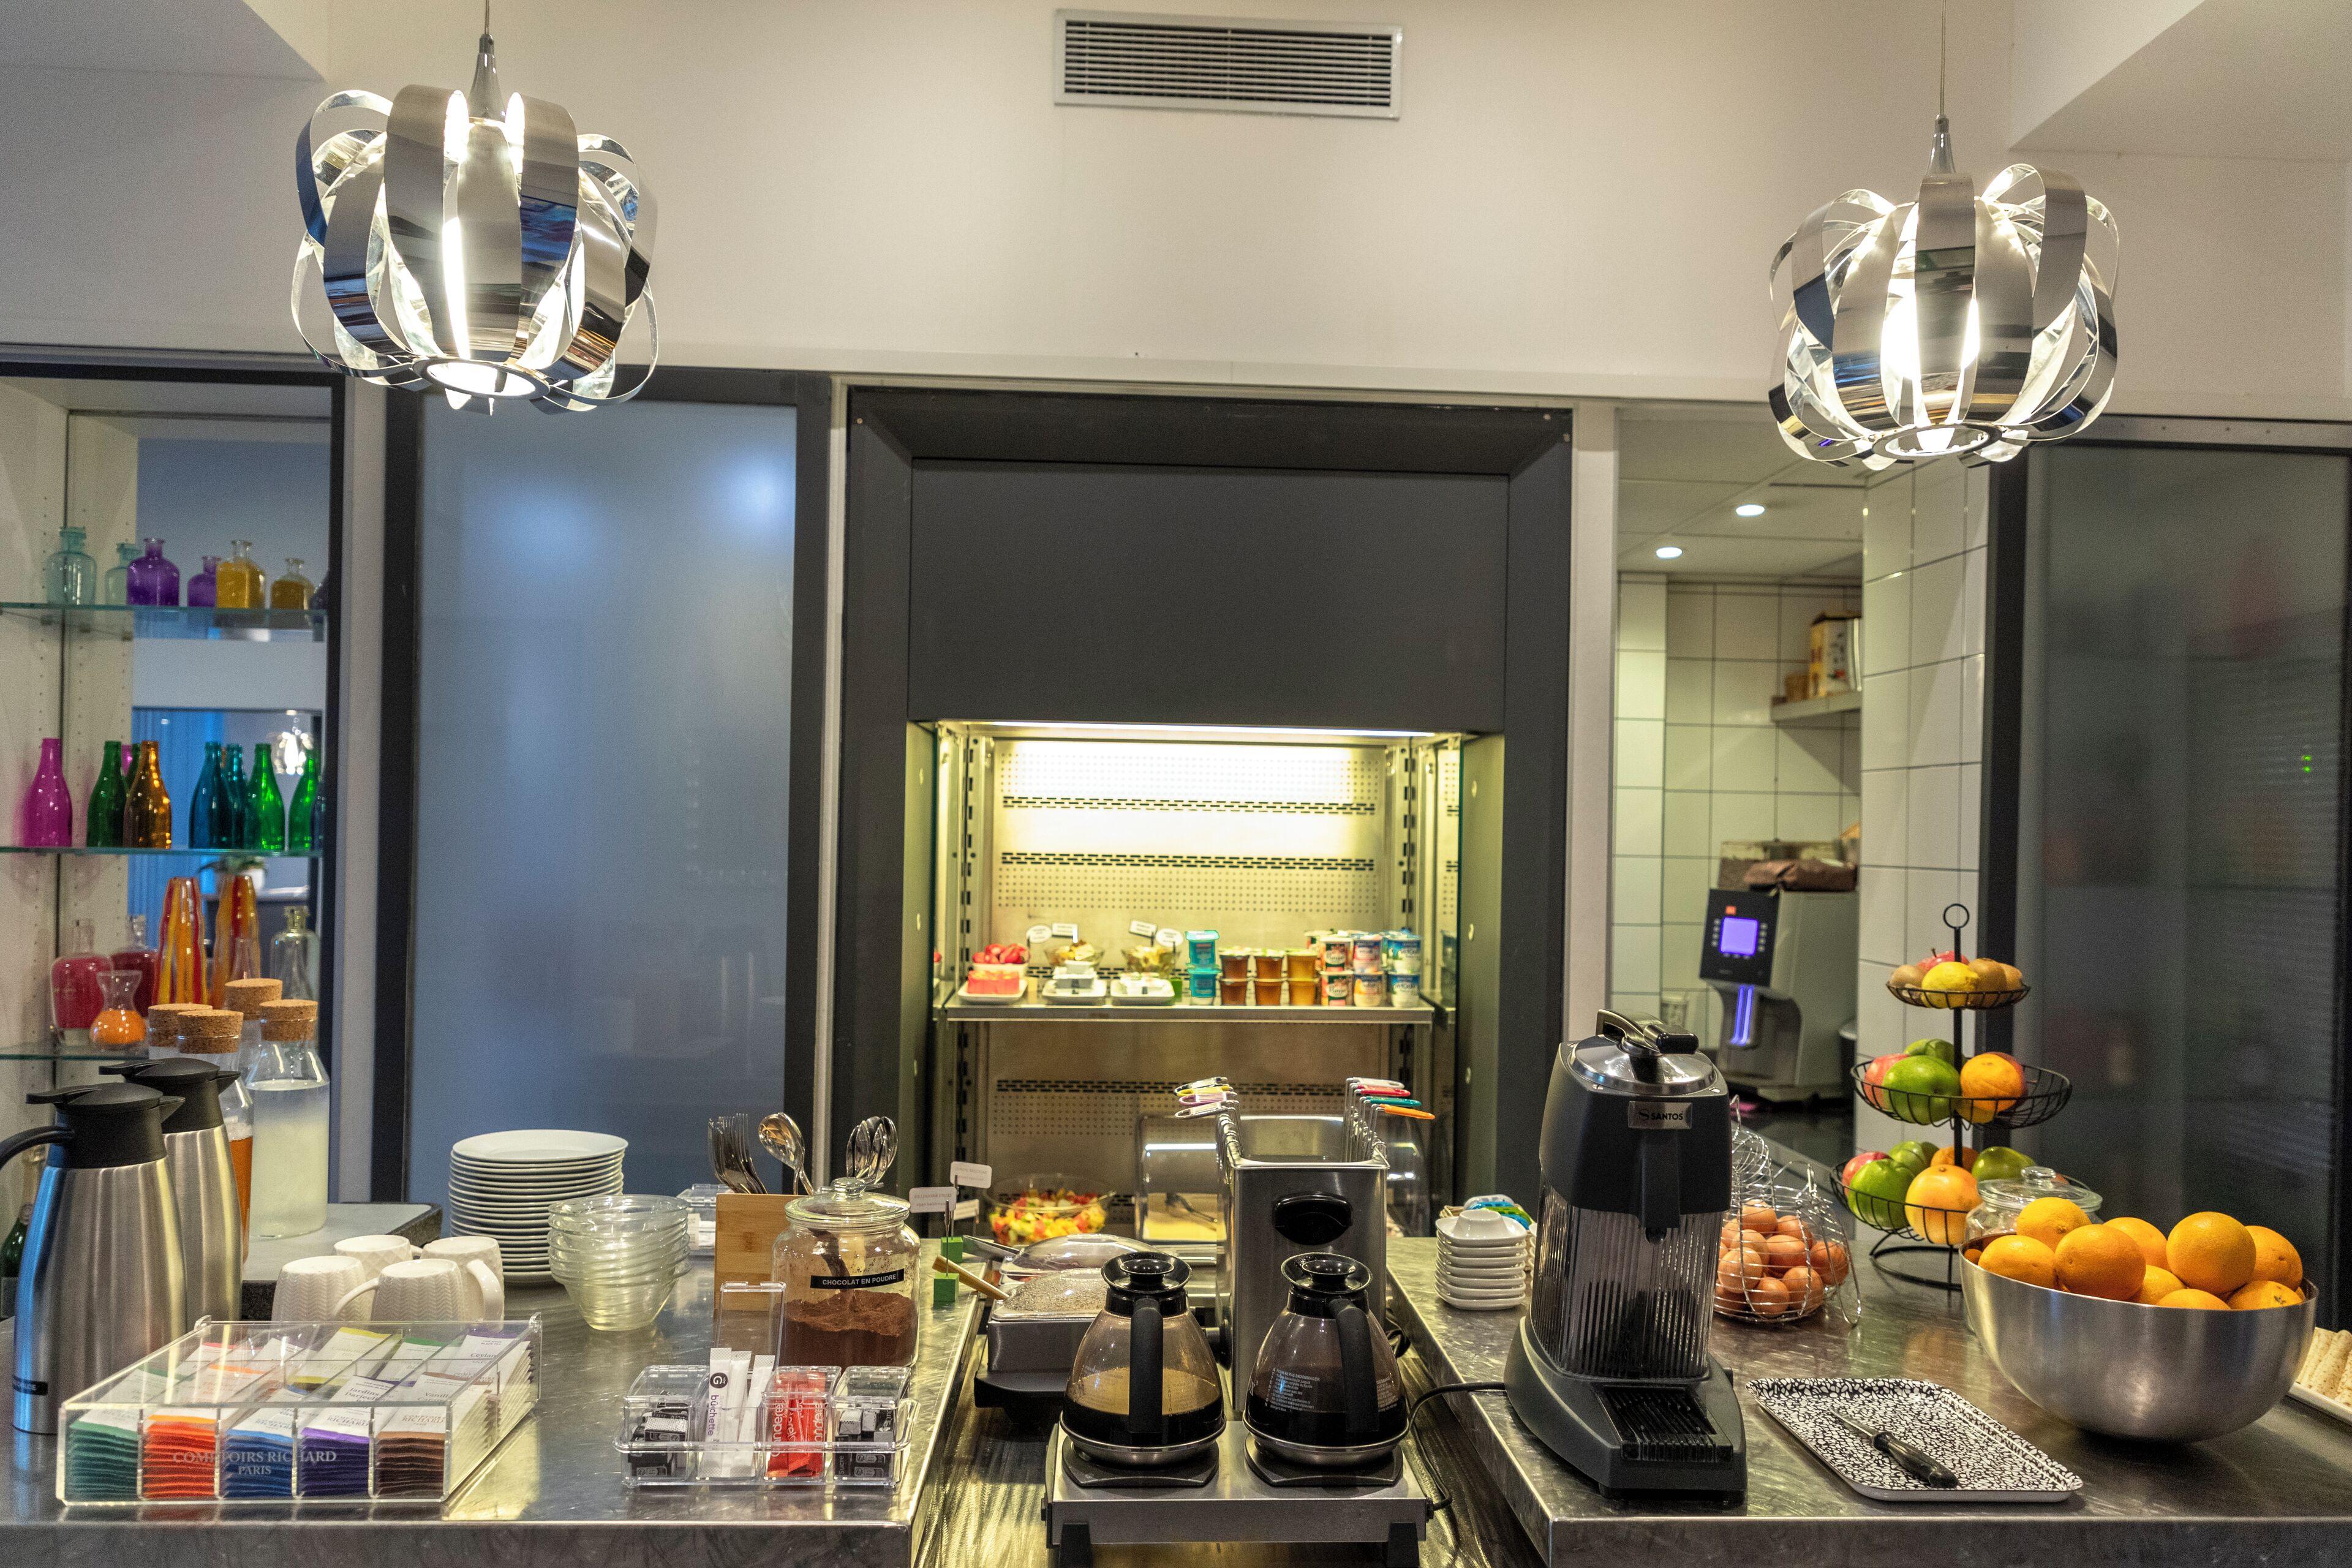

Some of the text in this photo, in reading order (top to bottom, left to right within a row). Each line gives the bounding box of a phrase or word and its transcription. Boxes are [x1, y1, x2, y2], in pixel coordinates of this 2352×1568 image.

[872, 1273, 896, 1283] POUDRE
[349, 1387, 380, 1396] Jardins
[707, 1395, 719, 1436] bûchette
[771, 1401, 784, 1457] Cndere
[173, 1450, 337, 1463] COMPTOIRS RICHARD
[238, 1466, 272, 1475] PARIS
